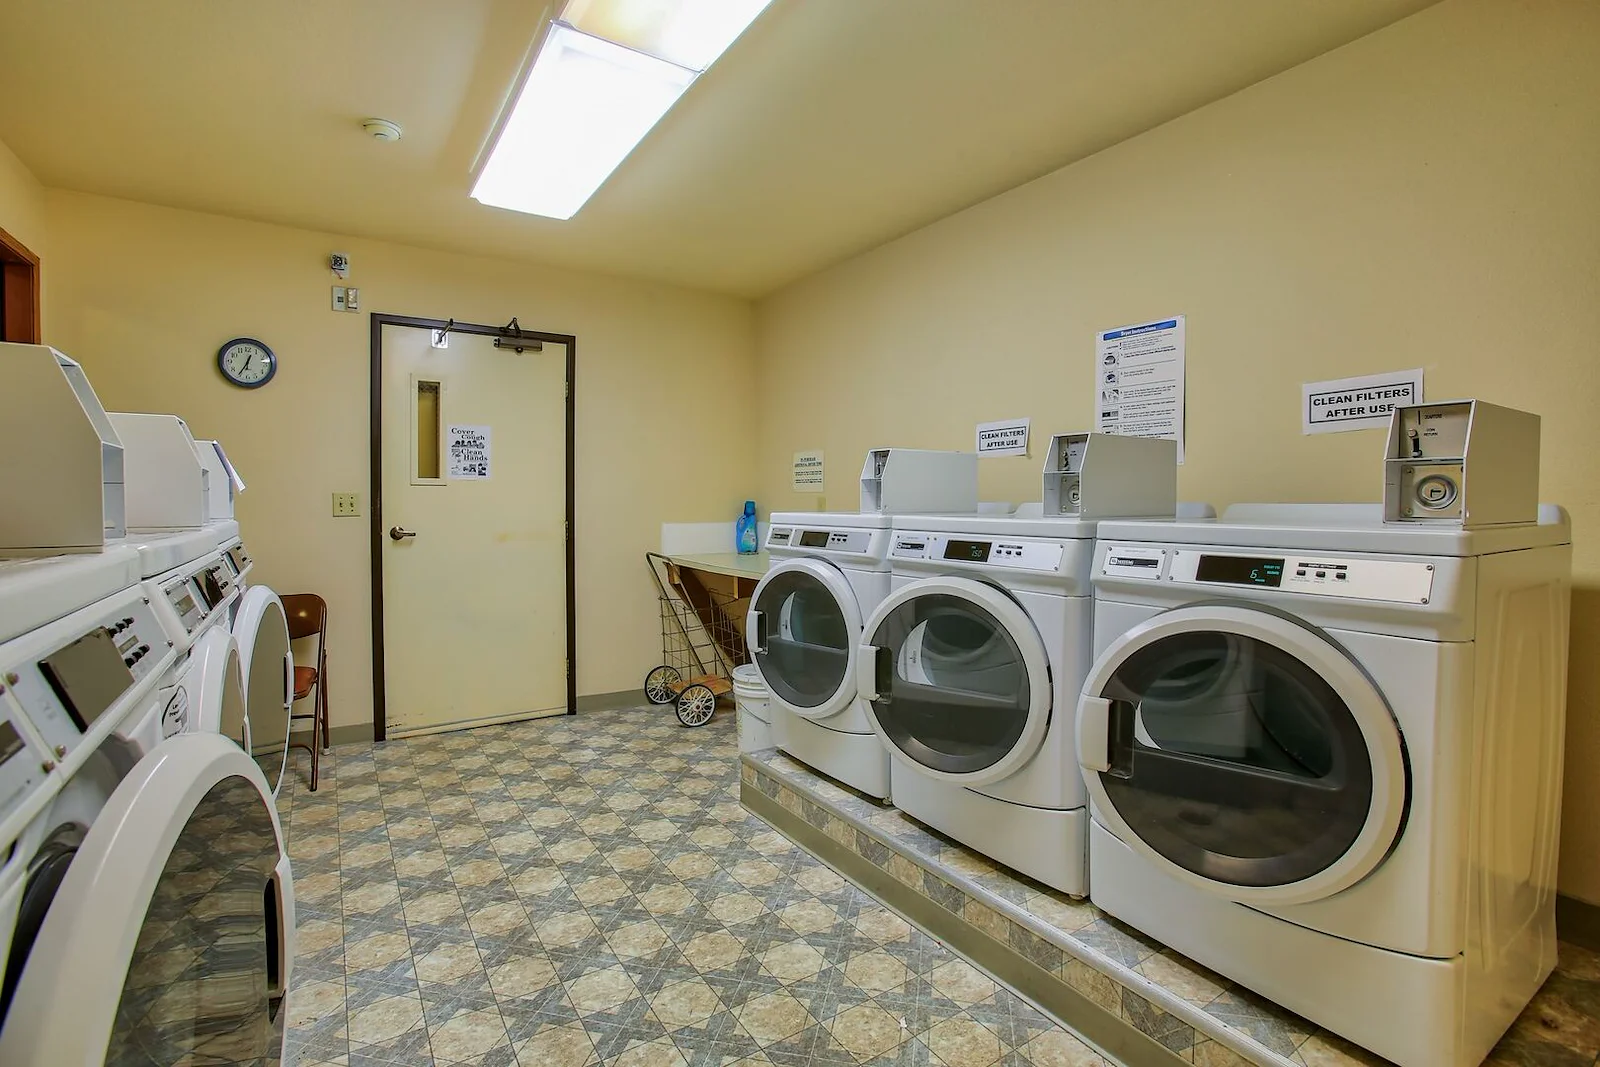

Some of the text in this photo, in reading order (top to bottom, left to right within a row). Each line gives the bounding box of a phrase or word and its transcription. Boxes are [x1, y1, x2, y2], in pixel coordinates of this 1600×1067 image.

[1313, 388, 1410, 406] CLEAN FILTERS
[1325, 403, 1396, 418] AFTER USE
[1250, 569, 1259, 578] 6
